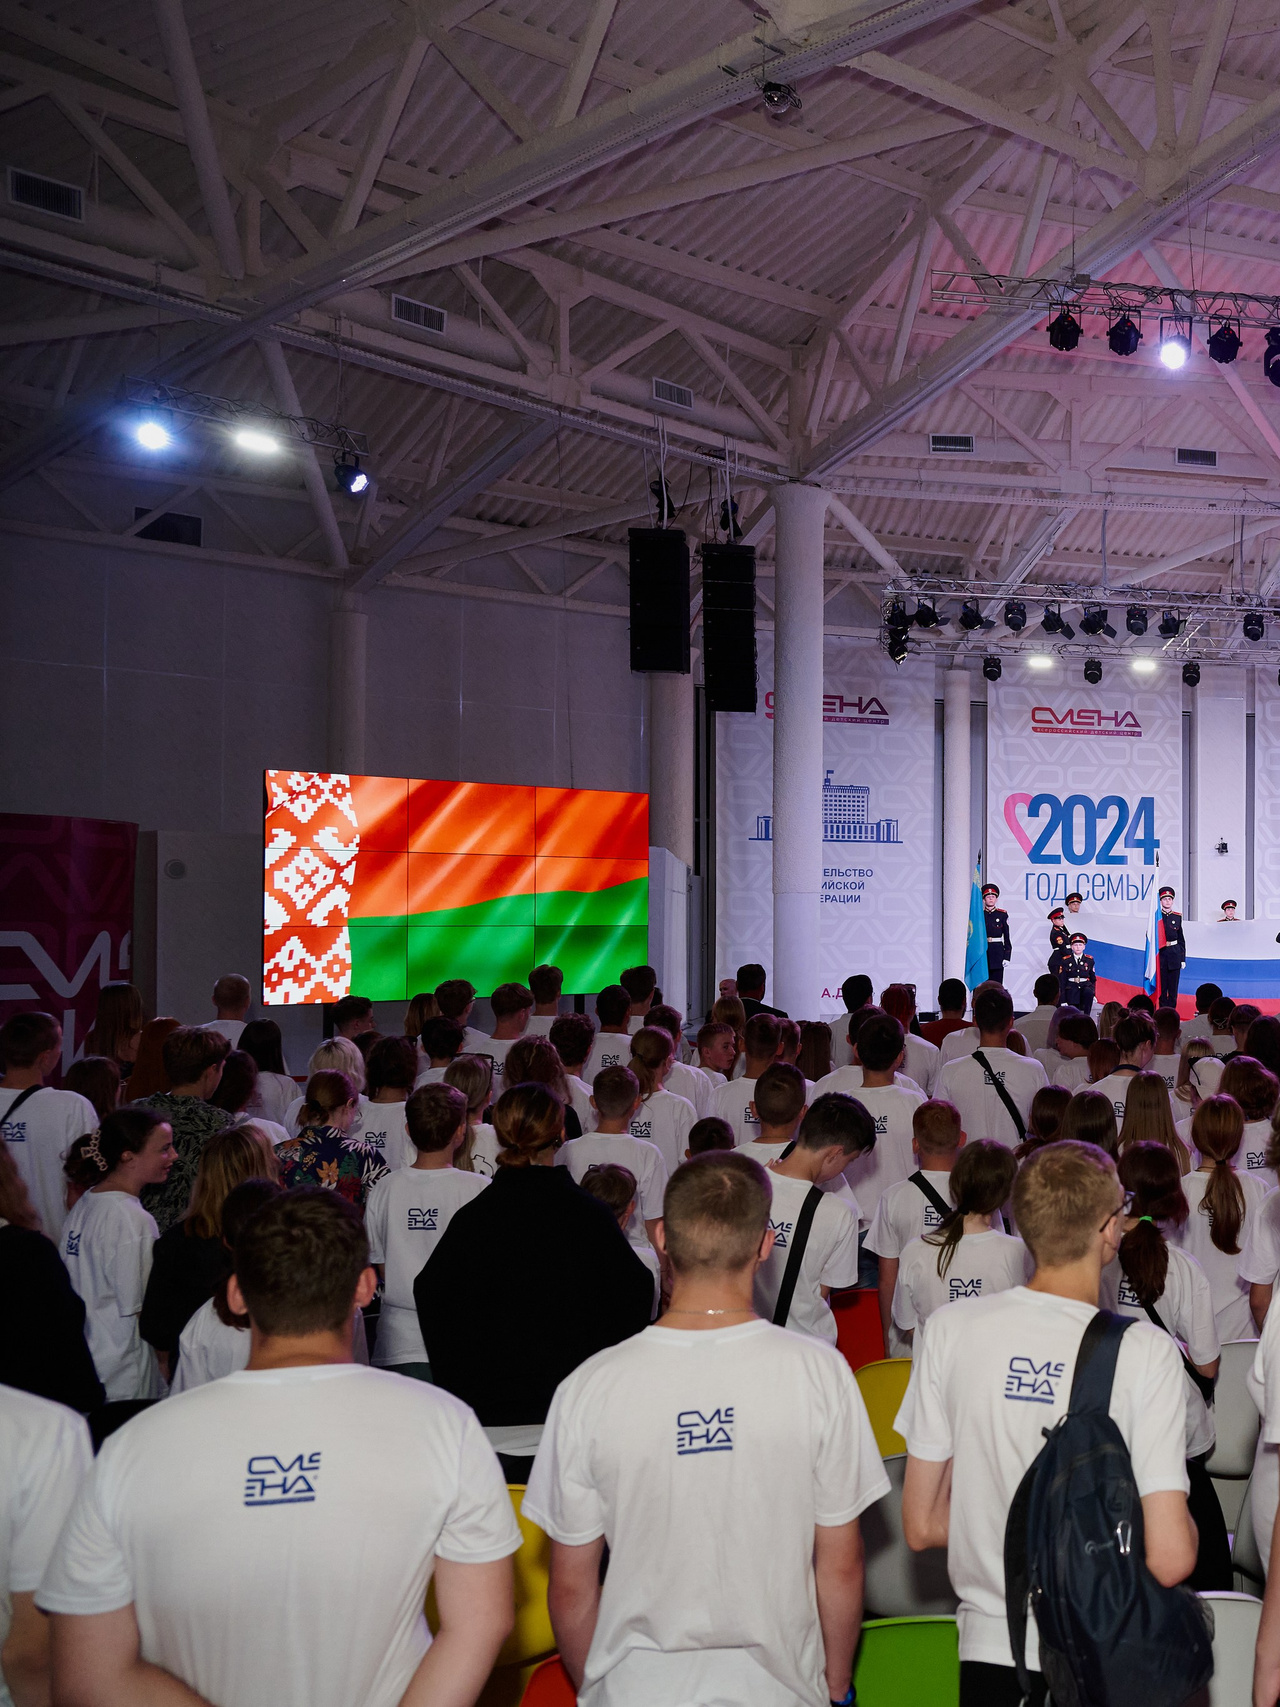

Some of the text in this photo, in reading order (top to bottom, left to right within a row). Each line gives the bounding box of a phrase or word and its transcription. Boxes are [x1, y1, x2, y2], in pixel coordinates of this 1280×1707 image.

[1031, 707, 1142, 728] СМЕНА
[1027, 793, 1160, 866] 2024
[823, 868, 873, 877] ЕЛЬСТВО
[821, 879, 865, 890] ИЙСКОЙ
[1025, 872, 1067, 906] ГОД
[820, 894, 861, 904] ЕРАЦИИ
